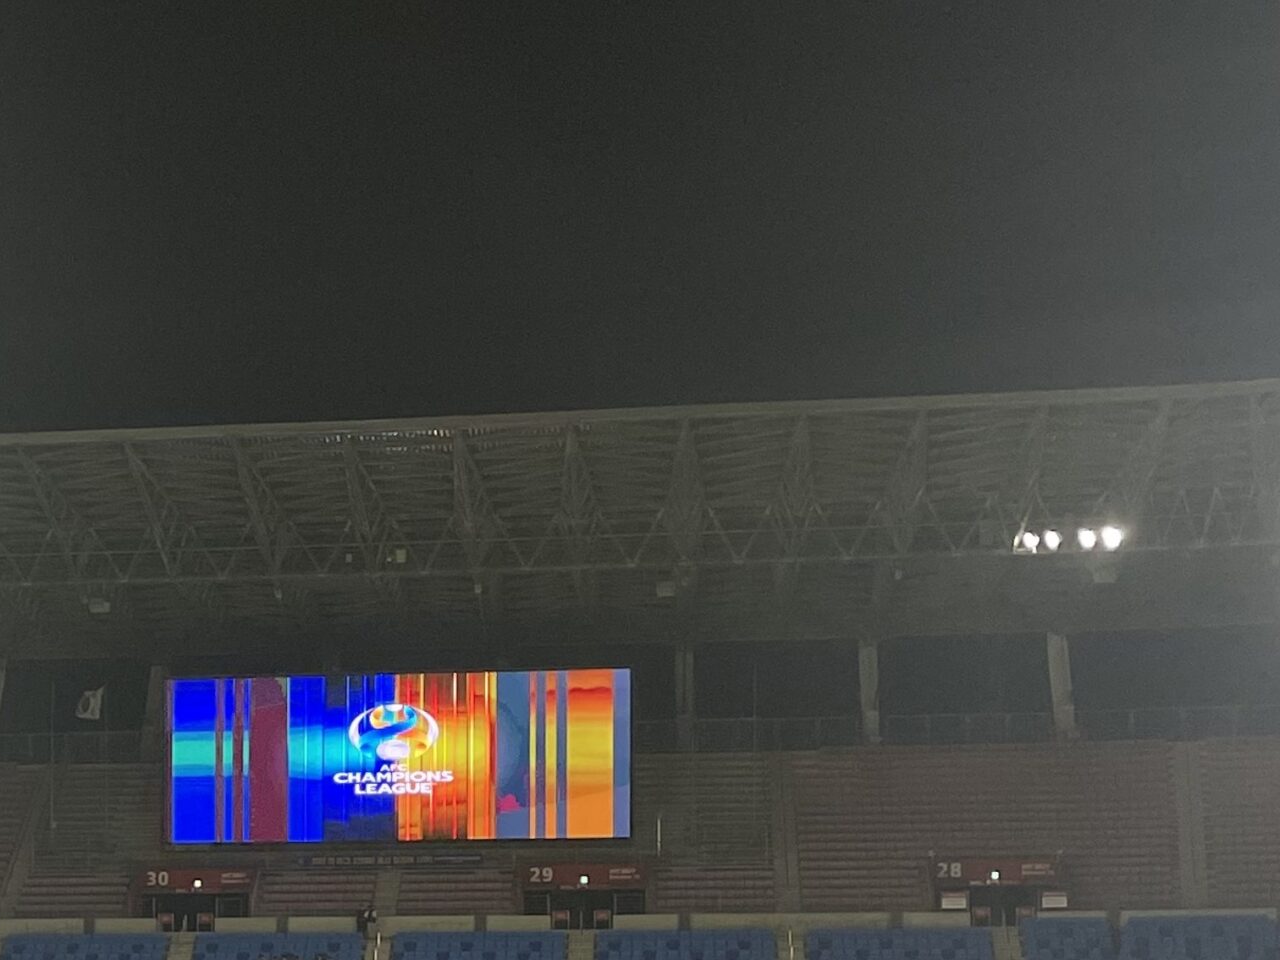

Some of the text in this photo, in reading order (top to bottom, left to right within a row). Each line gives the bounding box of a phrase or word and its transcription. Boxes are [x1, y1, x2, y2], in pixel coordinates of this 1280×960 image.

[380, 763, 408, 772] AFC
[333, 771, 454, 783] CHAMPIONS
[354, 783, 432, 795] LEAGUE
[529, 867, 553, 883] 29
[937, 863, 962, 878] 28
[146, 871, 169, 886] 30
